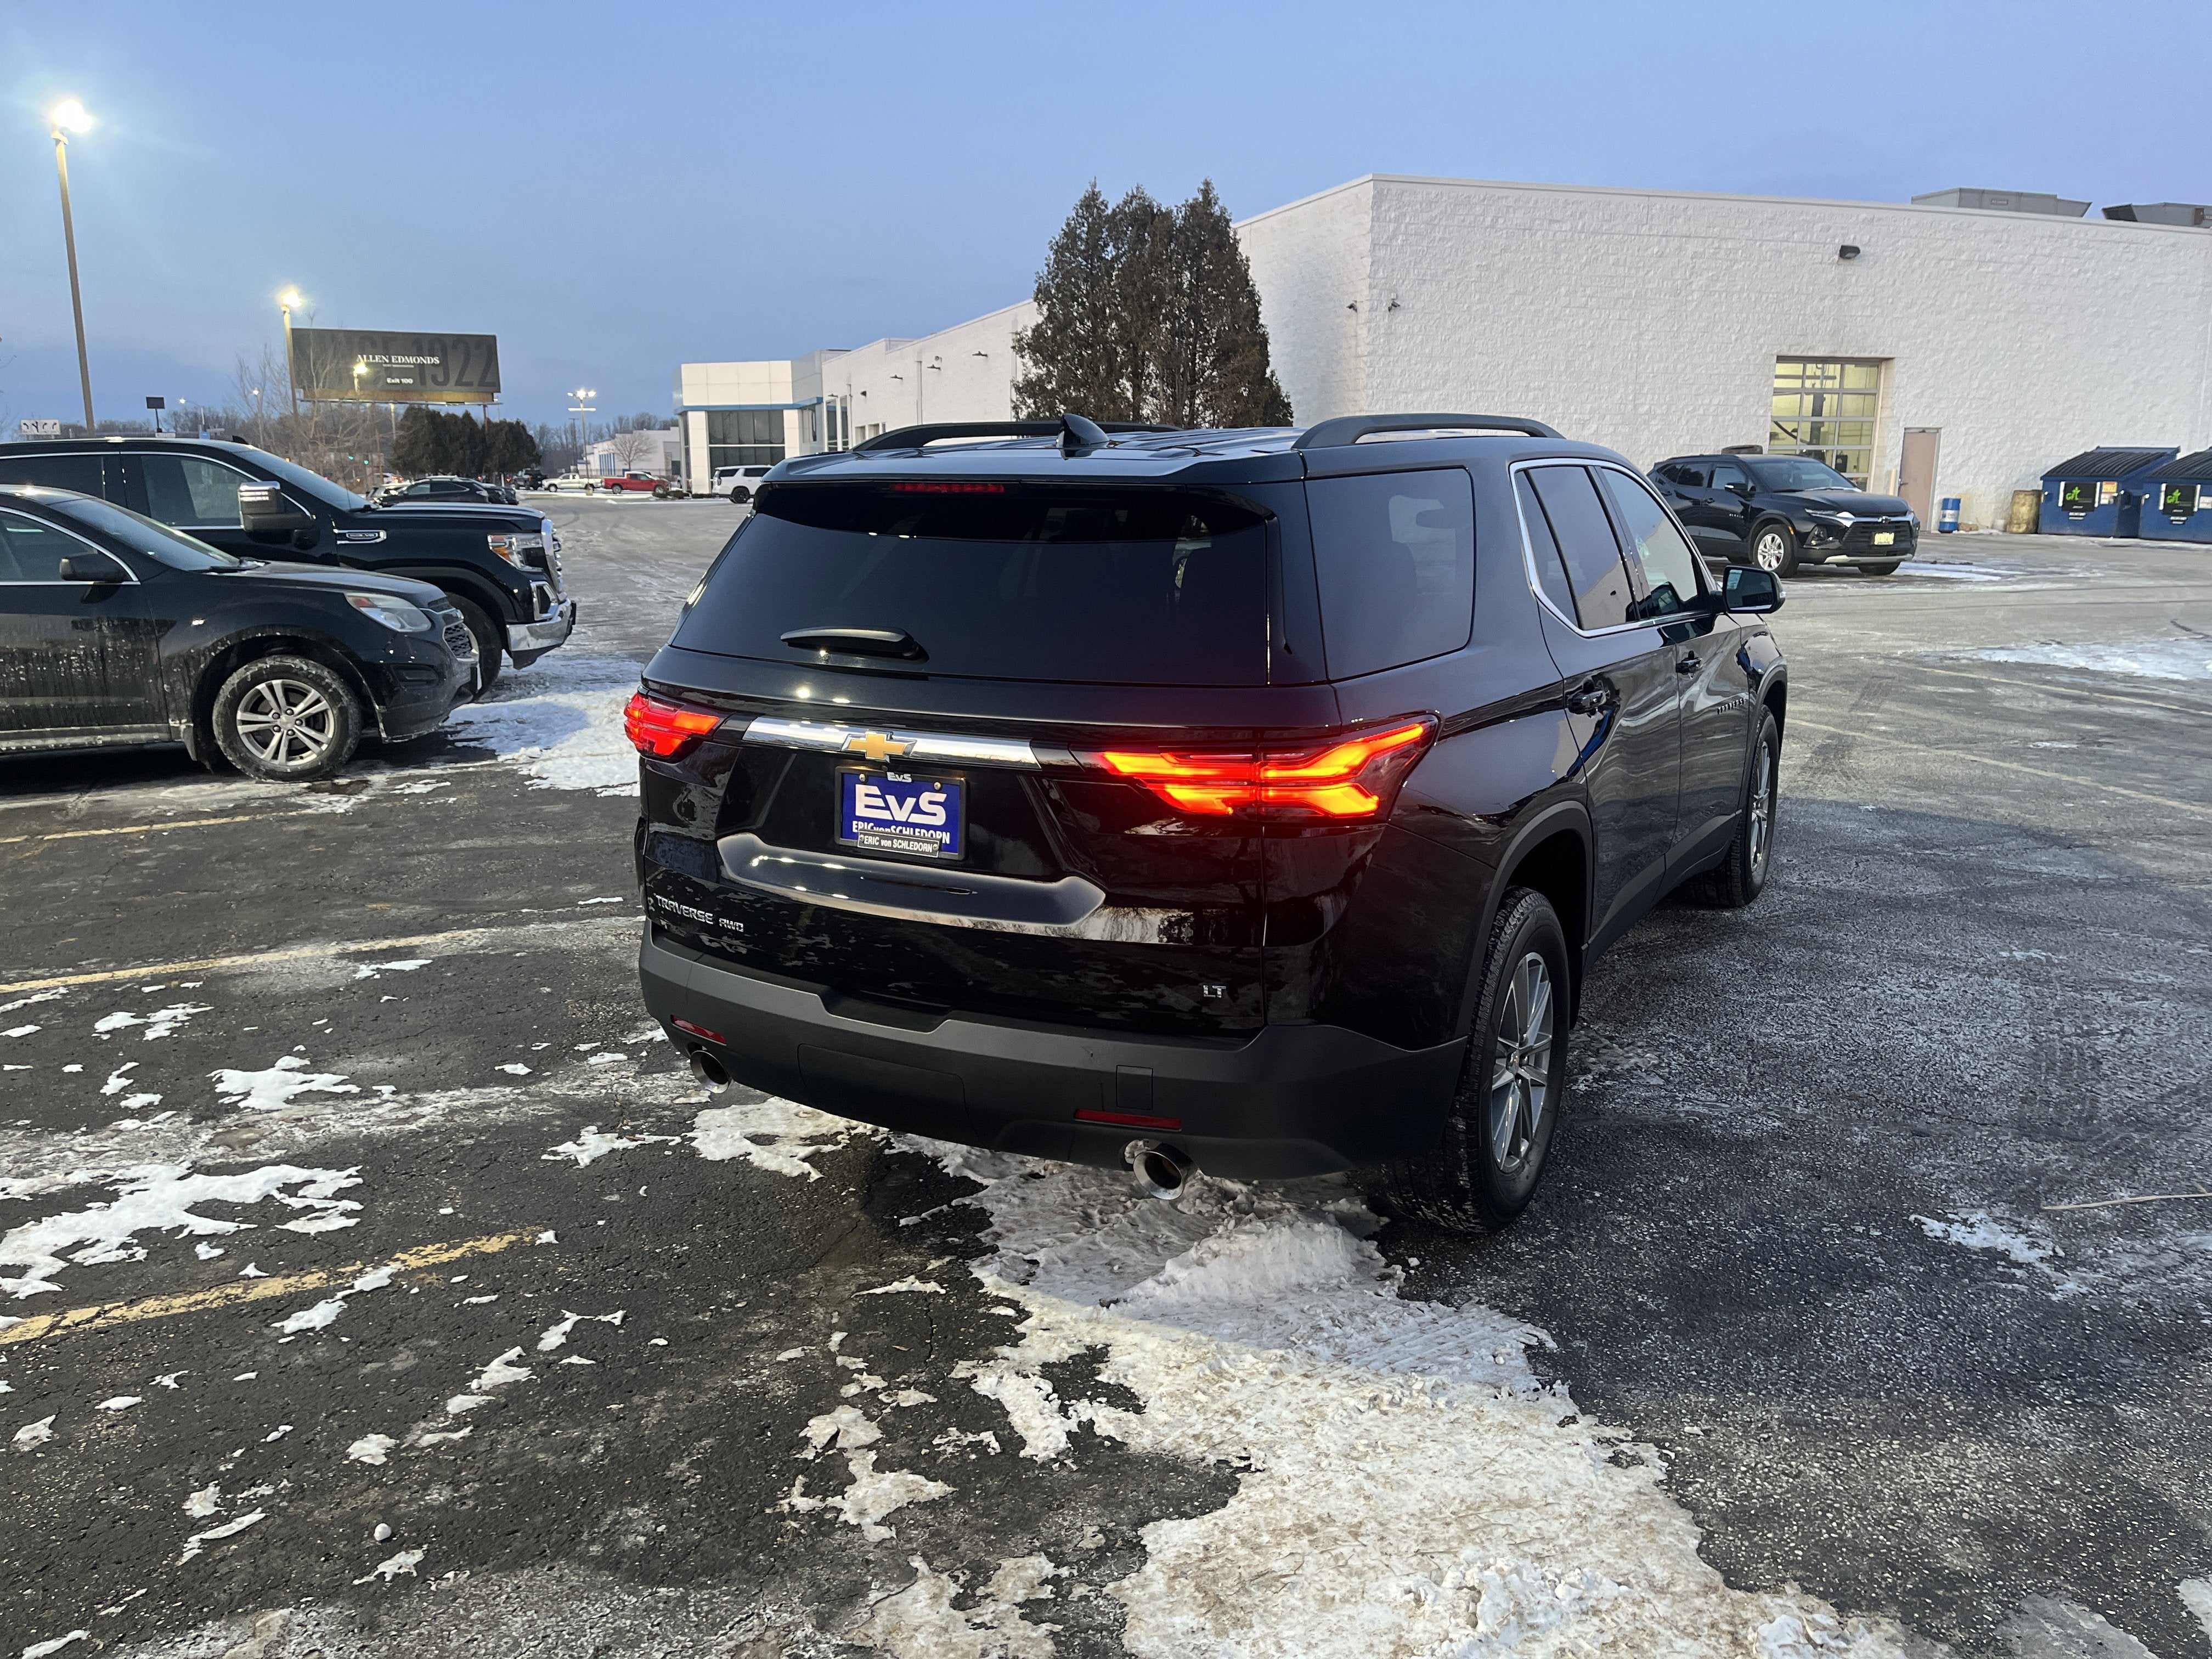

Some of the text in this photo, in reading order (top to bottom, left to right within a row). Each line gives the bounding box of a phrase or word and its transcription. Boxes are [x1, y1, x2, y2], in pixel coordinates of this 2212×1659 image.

[357, 354, 440, 364] ALLEN EDMONDS
[411, 337, 496, 386] 1922
[864, 835, 933, 853] ERIC von SCHLEDORN
[656, 894, 714, 925] TRAVERSE
[1203, 985, 1227, 998] LT
